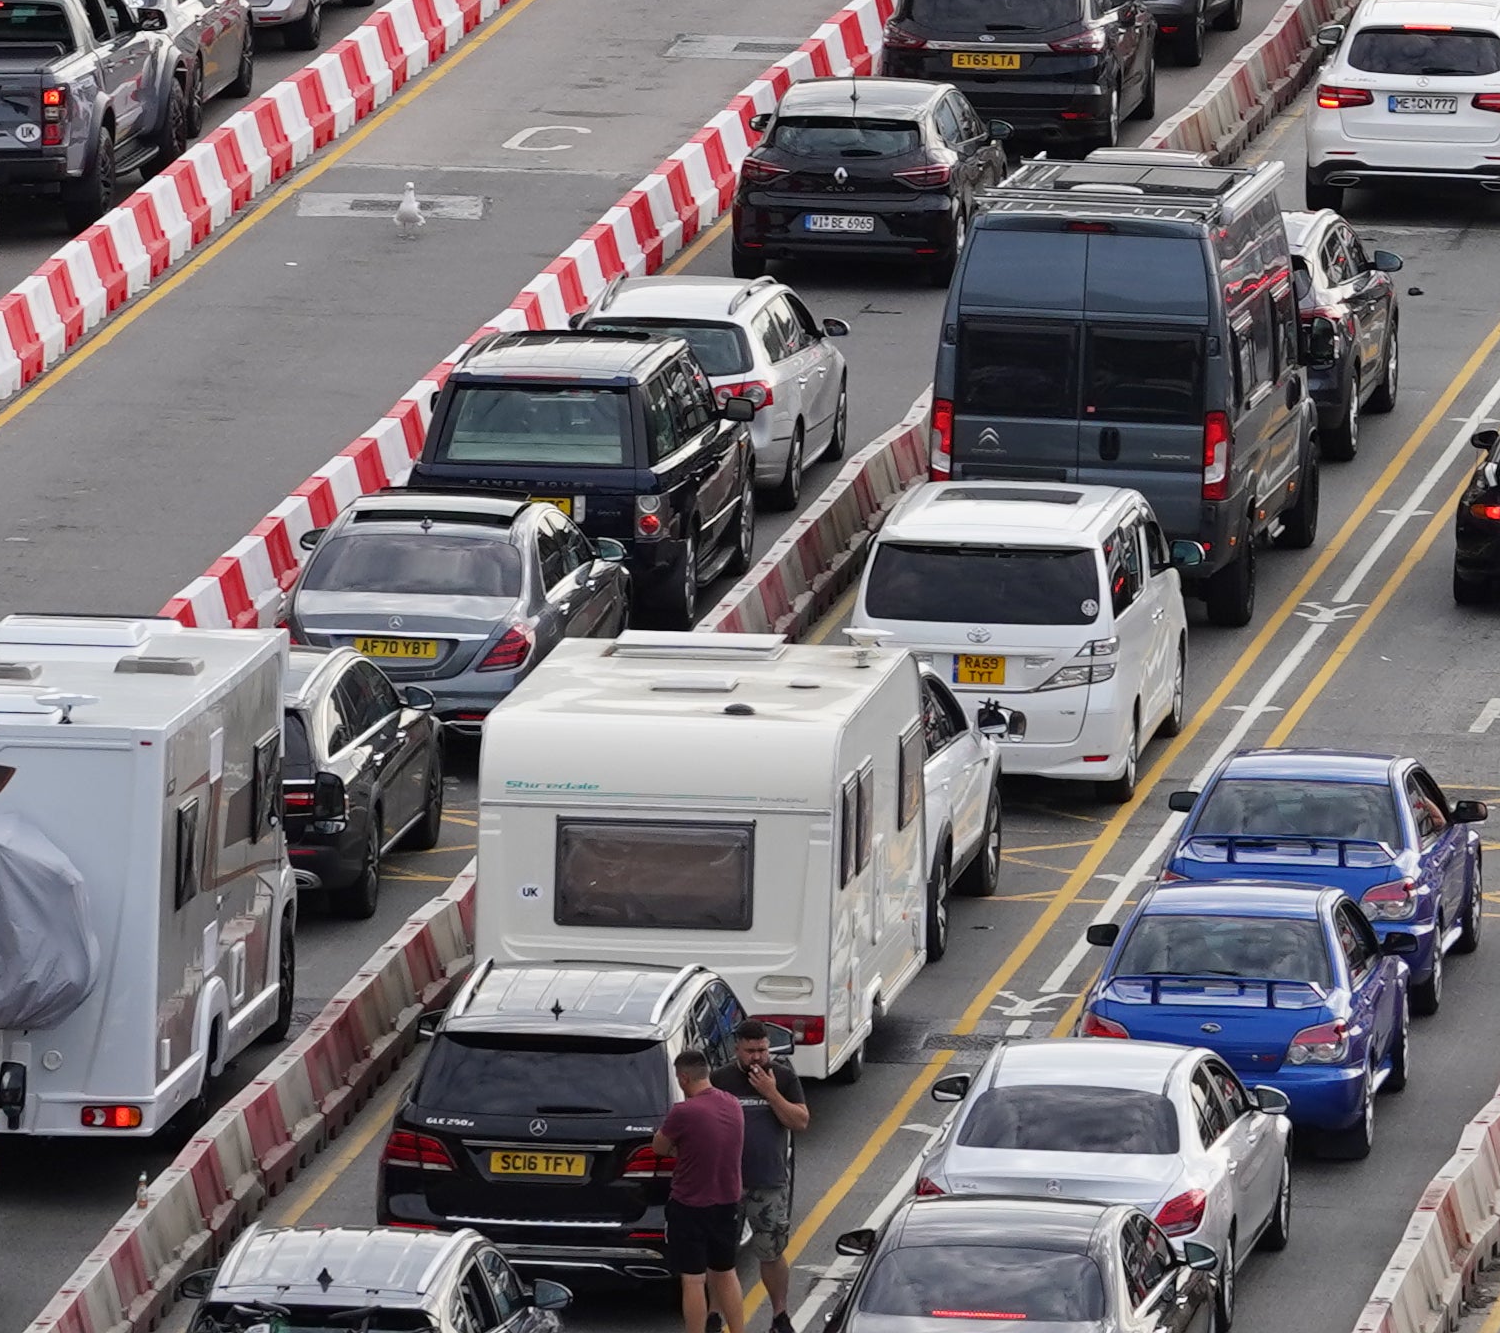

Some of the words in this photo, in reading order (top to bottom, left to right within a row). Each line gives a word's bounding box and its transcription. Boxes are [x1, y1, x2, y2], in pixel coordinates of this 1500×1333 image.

[957, 54, 987, 66] ET65
[991, 54, 1015, 67] LTA
[1395, 97, 1410, 110] ME
[1417, 97, 1433, 110] CN
[1435, 97, 1456, 110] 777
[21, 129, 36, 138] UK
[501, 125, 593, 151] C
[847, 217, 873, 230] 6965
[361, 637, 399, 654] AF70
[403, 639, 432, 655] YBT
[970, 670, 993, 683] TYT
[522, 887, 539, 898] UK
[425, 1116, 445, 1127] GLE
[500, 1154, 538, 1170] SC16
[543, 1156, 577, 1173] TFY
